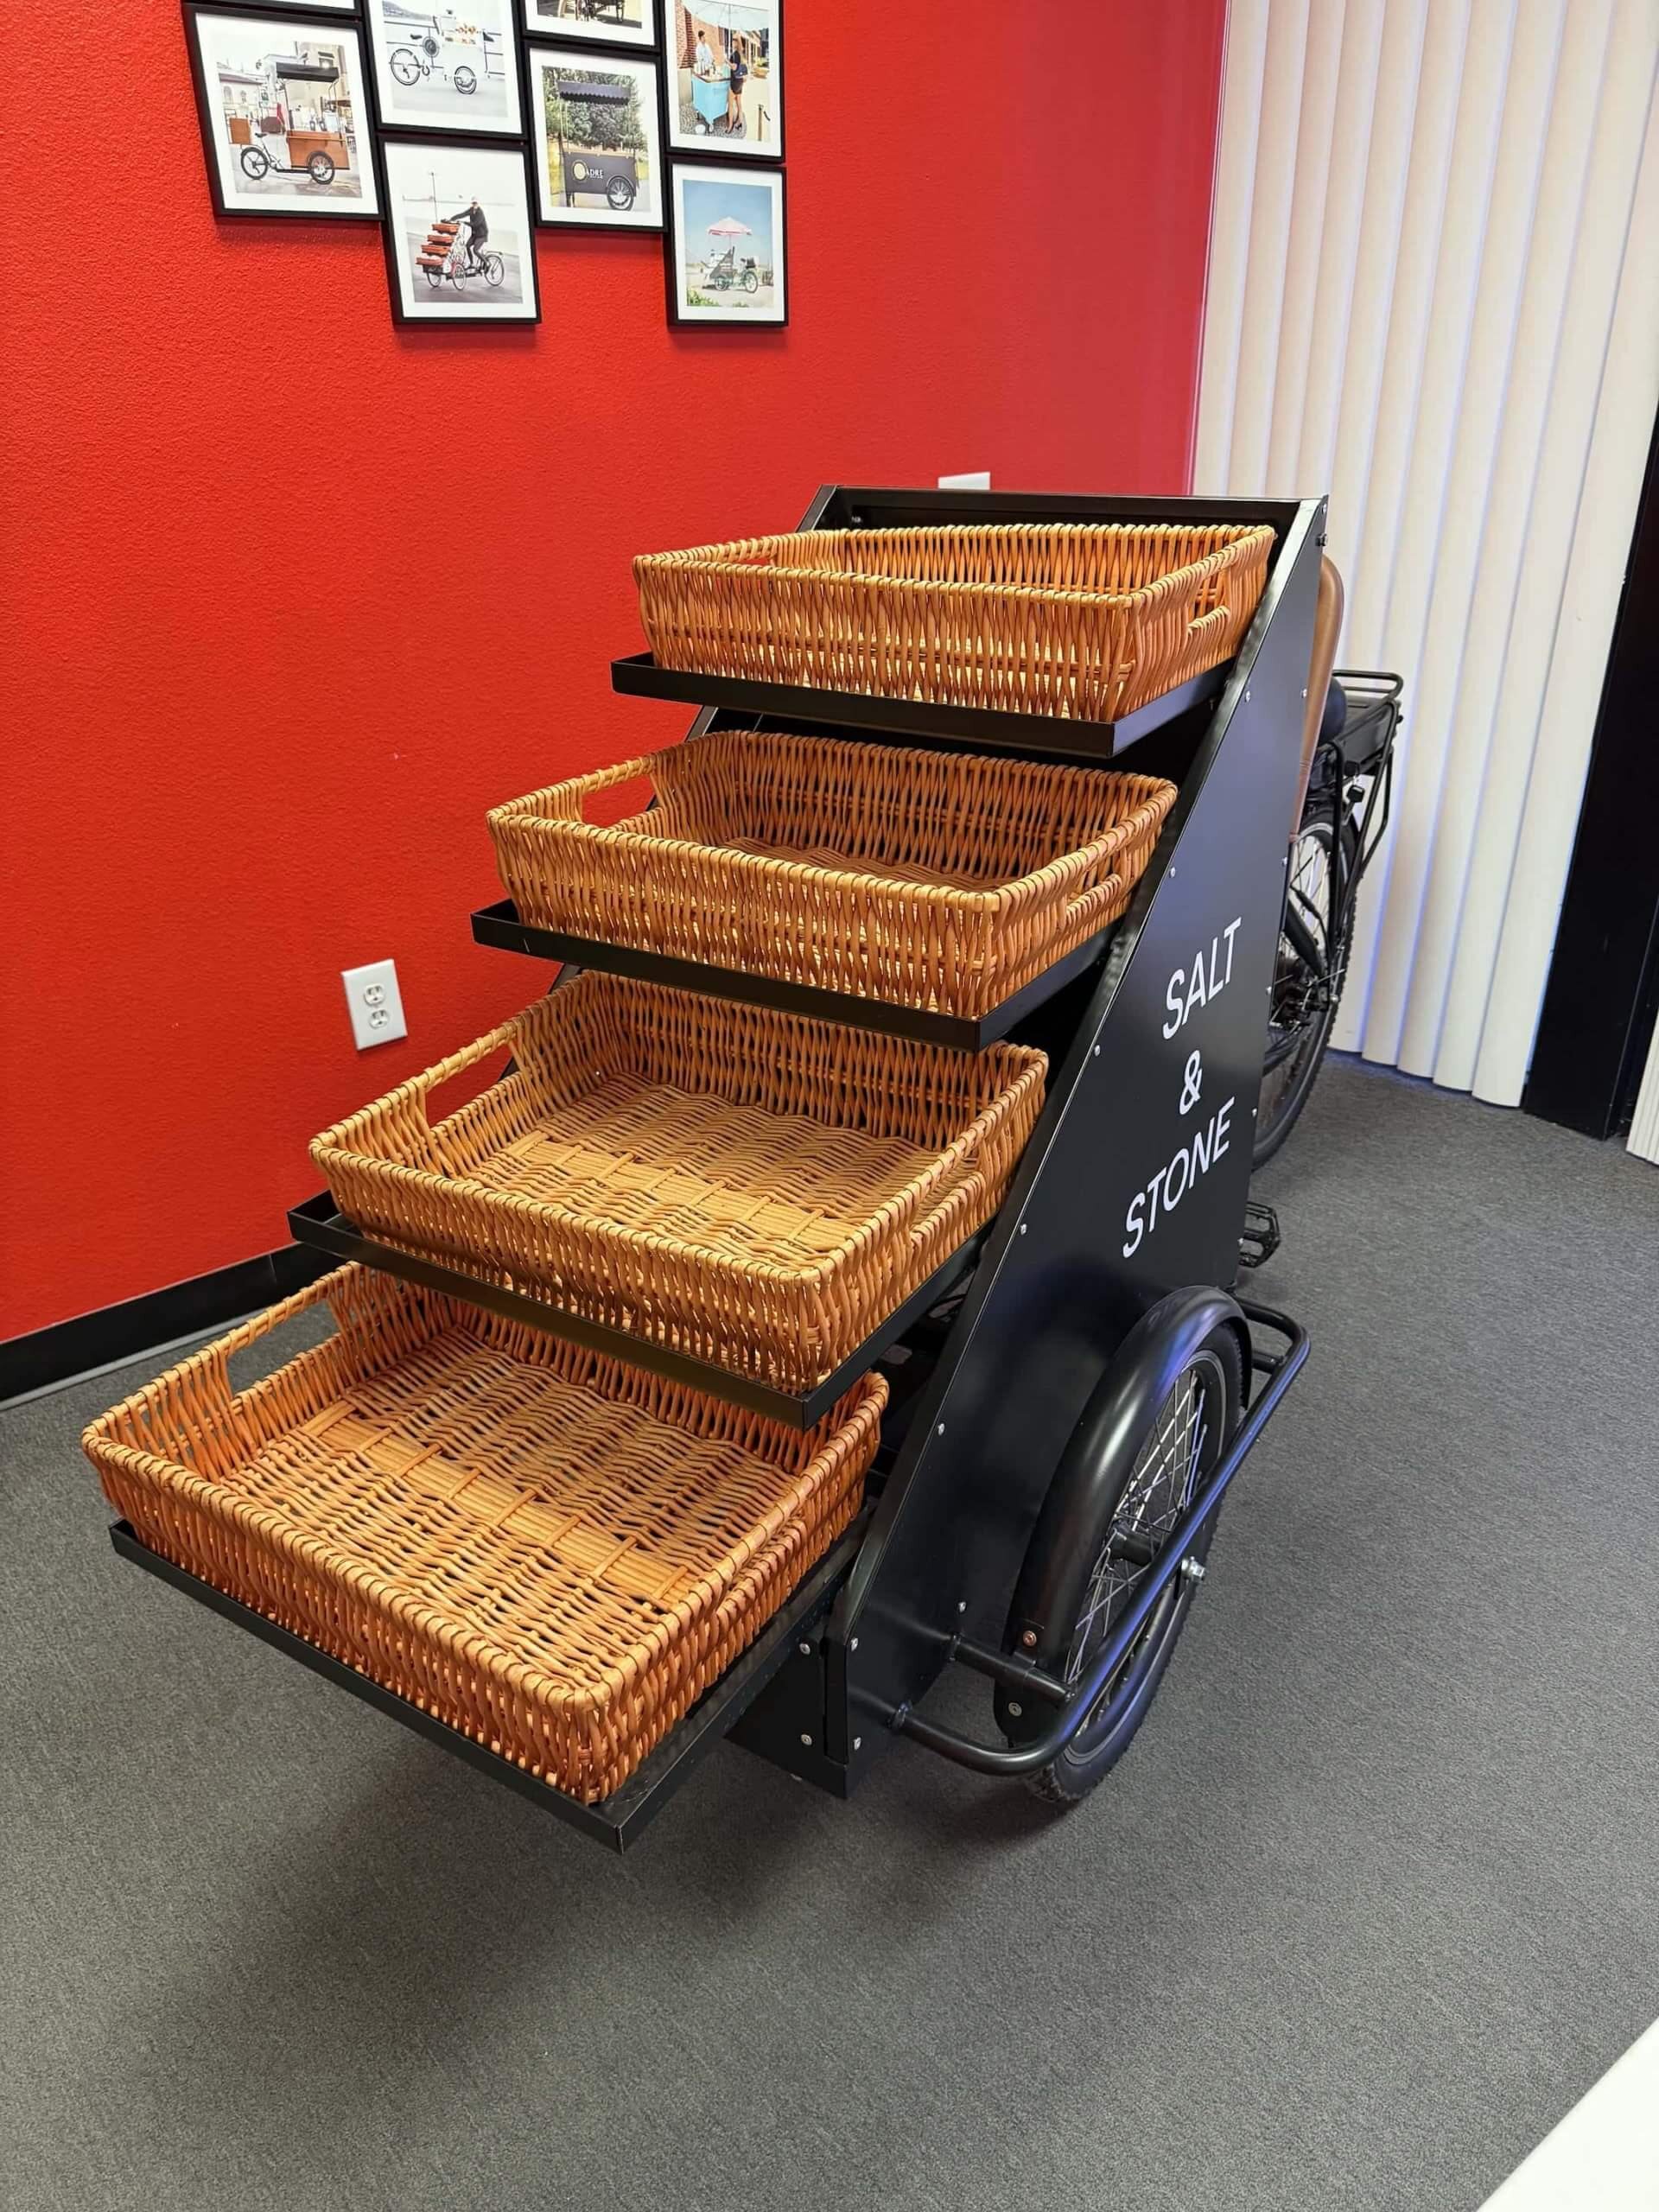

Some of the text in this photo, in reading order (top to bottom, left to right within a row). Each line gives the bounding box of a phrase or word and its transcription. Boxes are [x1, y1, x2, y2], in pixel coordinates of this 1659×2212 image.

[1162, 916, 1242, 1040] SALT
[1179, 1050, 1203, 1116] &
[1122, 1096, 1235, 1258] STONE
